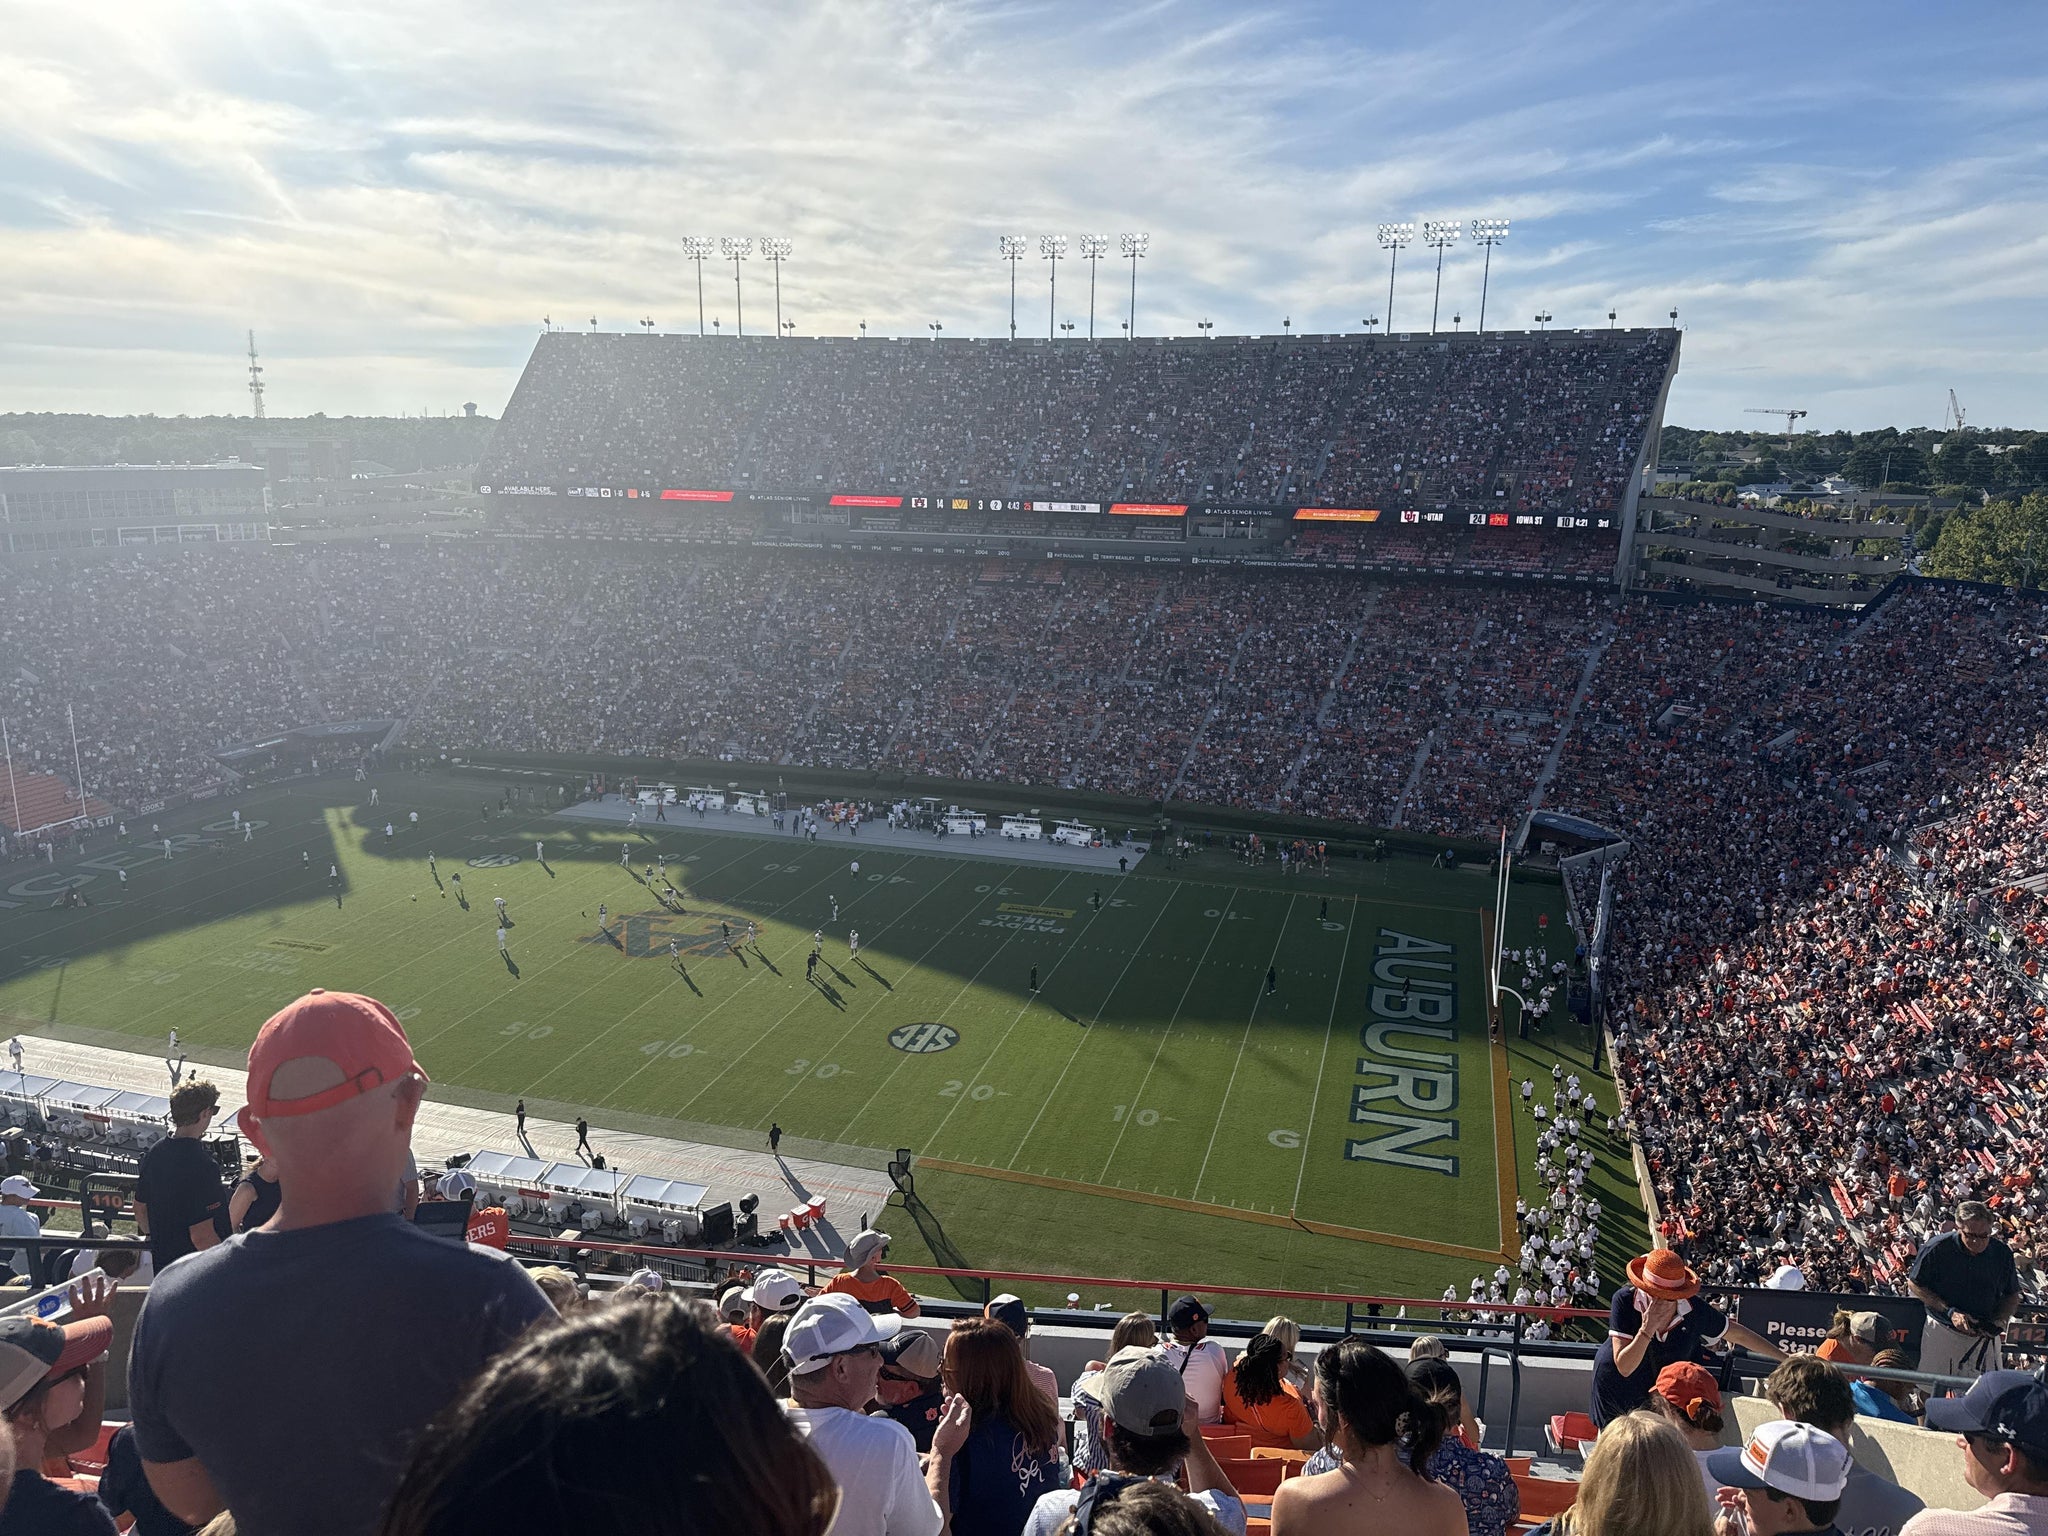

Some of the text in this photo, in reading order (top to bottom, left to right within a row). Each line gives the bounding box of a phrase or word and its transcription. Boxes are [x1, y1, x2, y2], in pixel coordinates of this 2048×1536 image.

[1427, 513, 1444, 522] UTAH
[1472, 514, 1482, 524] 24
[1516, 516, 1544, 525] IOWA ST
[1561, 517, 1570, 527] 10
[1576, 518, 1588, 527] 4:21
[1598, 519, 1610, 528] 3rd
[1244, 560, 1276, 568] CONFERENCE
[140, 800, 165, 812] COOK'S
[97, 816, 114, 828] ETI
[996, 914, 1056, 926] FIELD
[499, 1021, 554, 1040] 50
[891, 1024, 957, 1052] SEC
[639, 1040, 694, 1059] 40
[1346, 927, 1458, 1176] AUBURN
[784, 1059, 840, 1079] 30
[938, 1080, 995, 1100] 20
[1112, 1104, 1160, 1126] 10
[1267, 1129, 1300, 1149] G
[92, 1194, 123, 1209] 110
[1767, 1322, 1827, 1338] Please
[2010, 1327, 2047, 1342] 112
[1778, 1340, 1818, 1354] Stan
